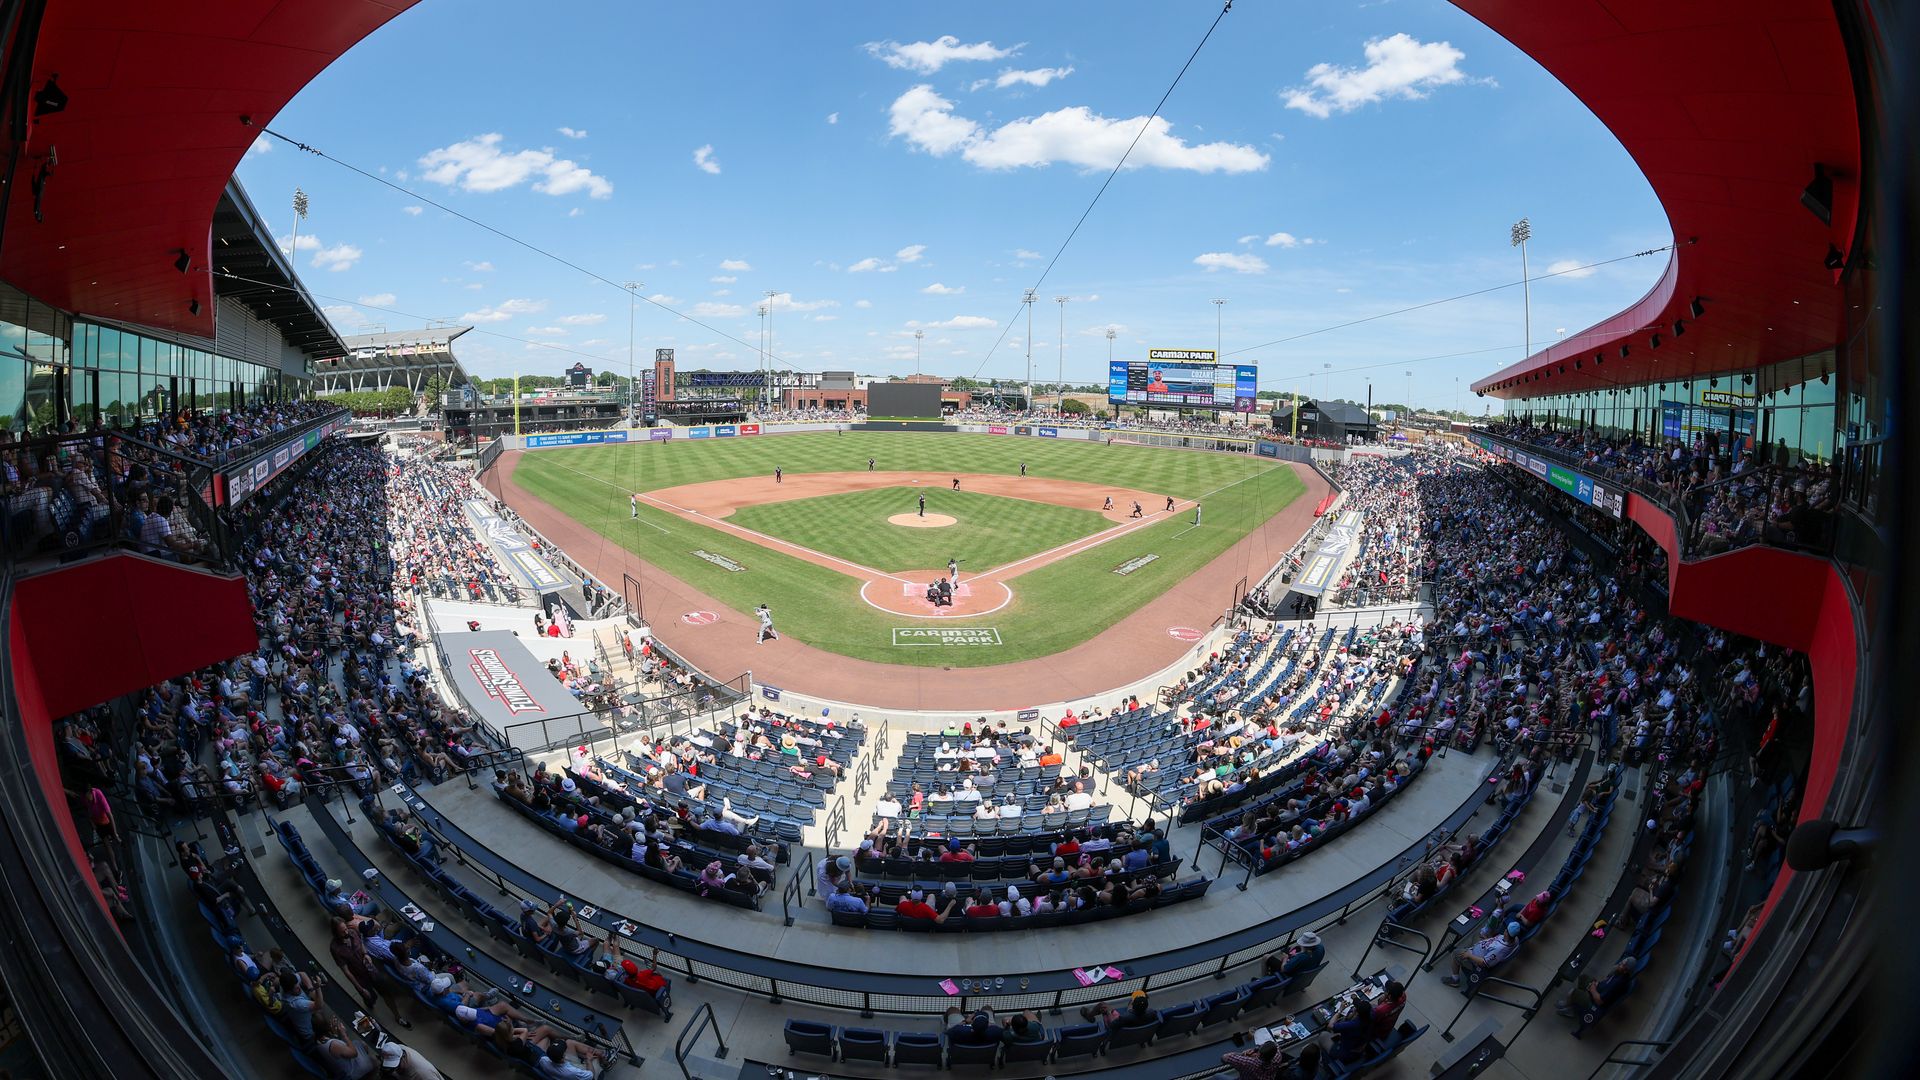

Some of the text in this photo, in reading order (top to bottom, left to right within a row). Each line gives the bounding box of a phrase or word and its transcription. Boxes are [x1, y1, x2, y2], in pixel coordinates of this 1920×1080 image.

[1190, 352, 1213, 360] PARK
[469, 648, 544, 714] FLYING SQUIRRELS
[471, 664, 500, 697] RICHMOND
